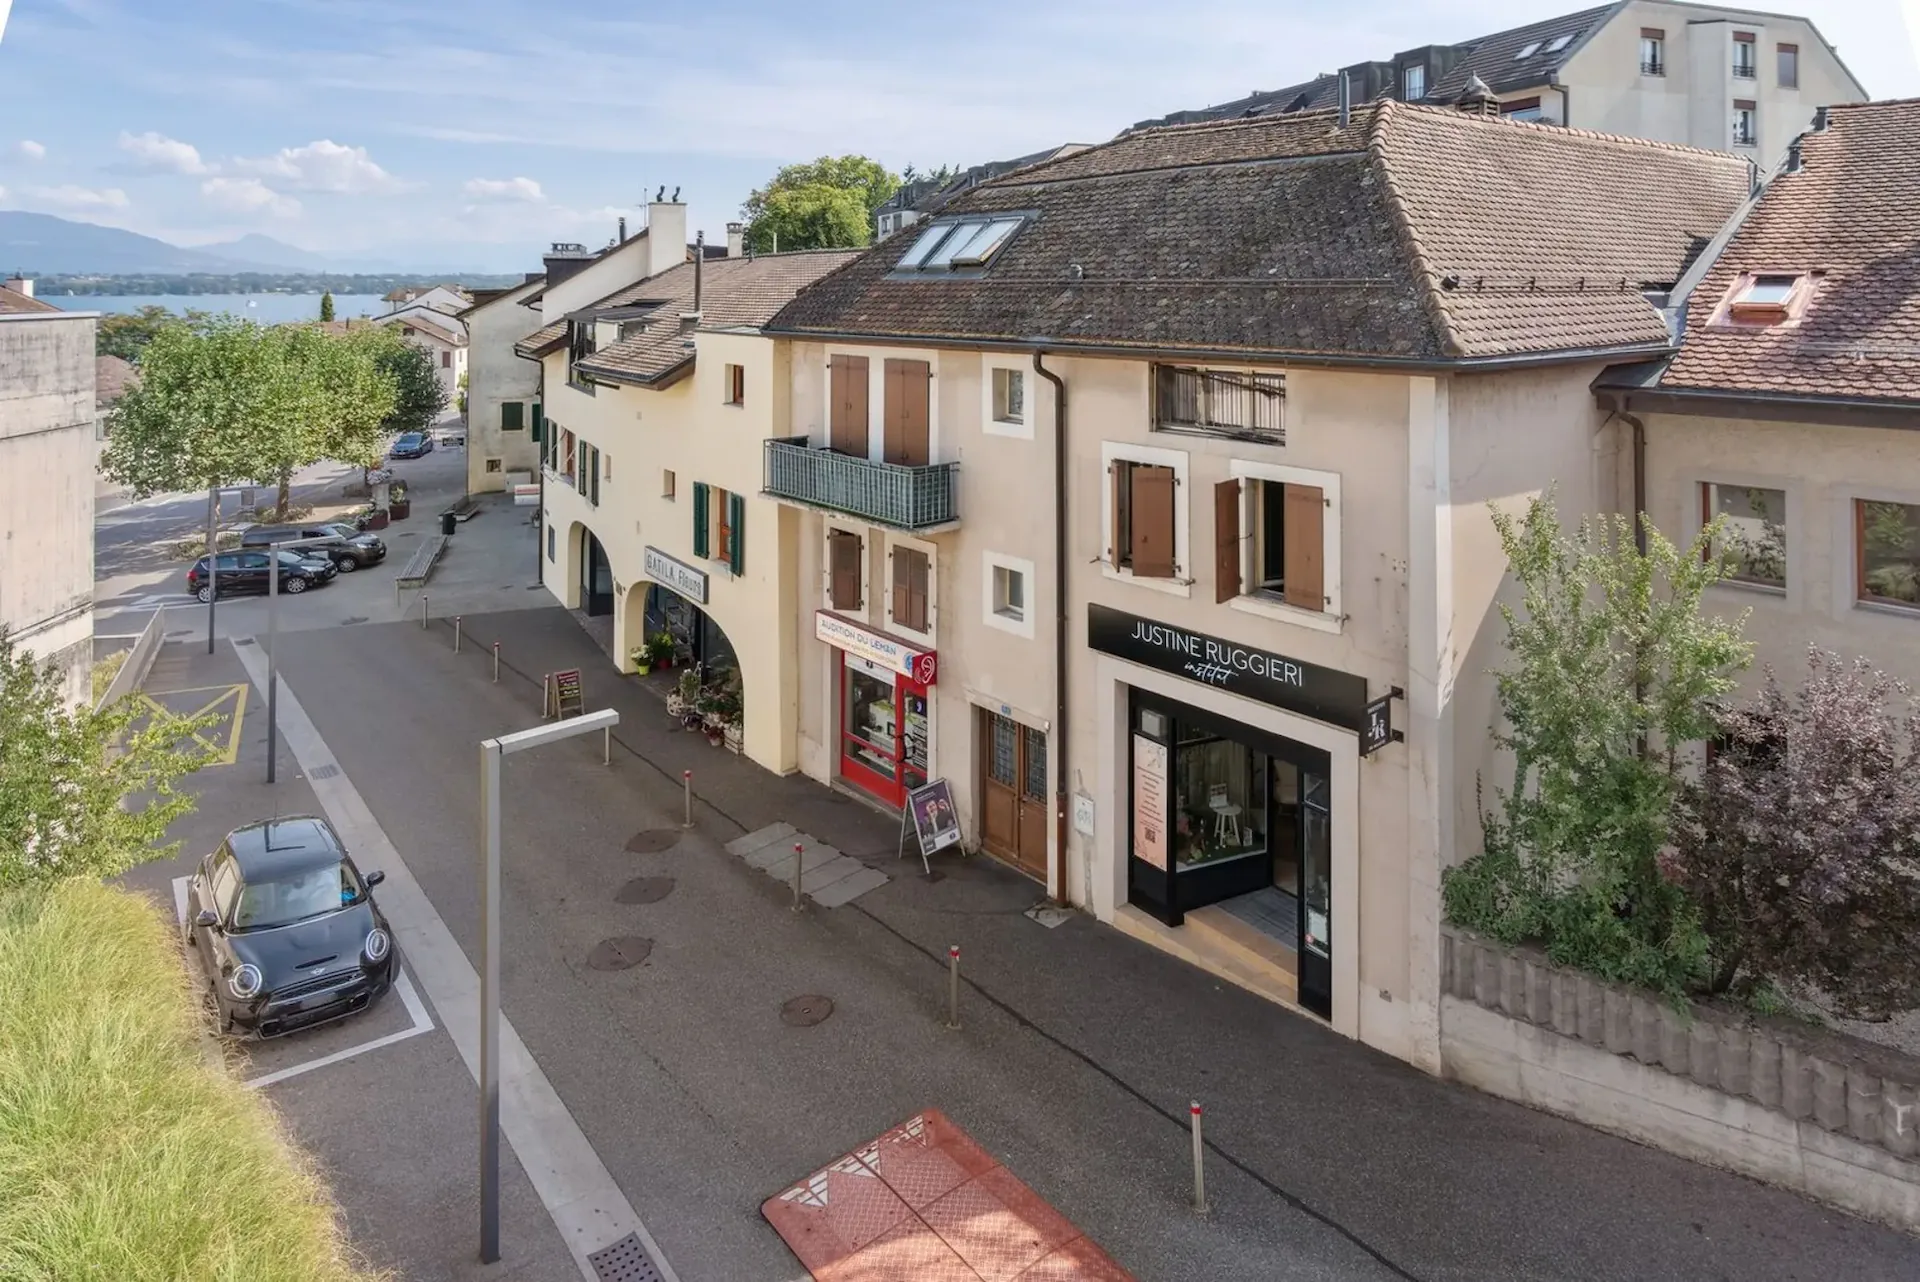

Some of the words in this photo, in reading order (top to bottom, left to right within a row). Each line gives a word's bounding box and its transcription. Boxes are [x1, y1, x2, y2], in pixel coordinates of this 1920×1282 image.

[821, 619, 856, 640] AUDITION
[856, 633, 869, 645] DU
[1131, 620, 1202, 658] JUSTINE
[1205, 640, 1303, 687] RUGGIERI
[1184, 660, 1240, 685] institut
